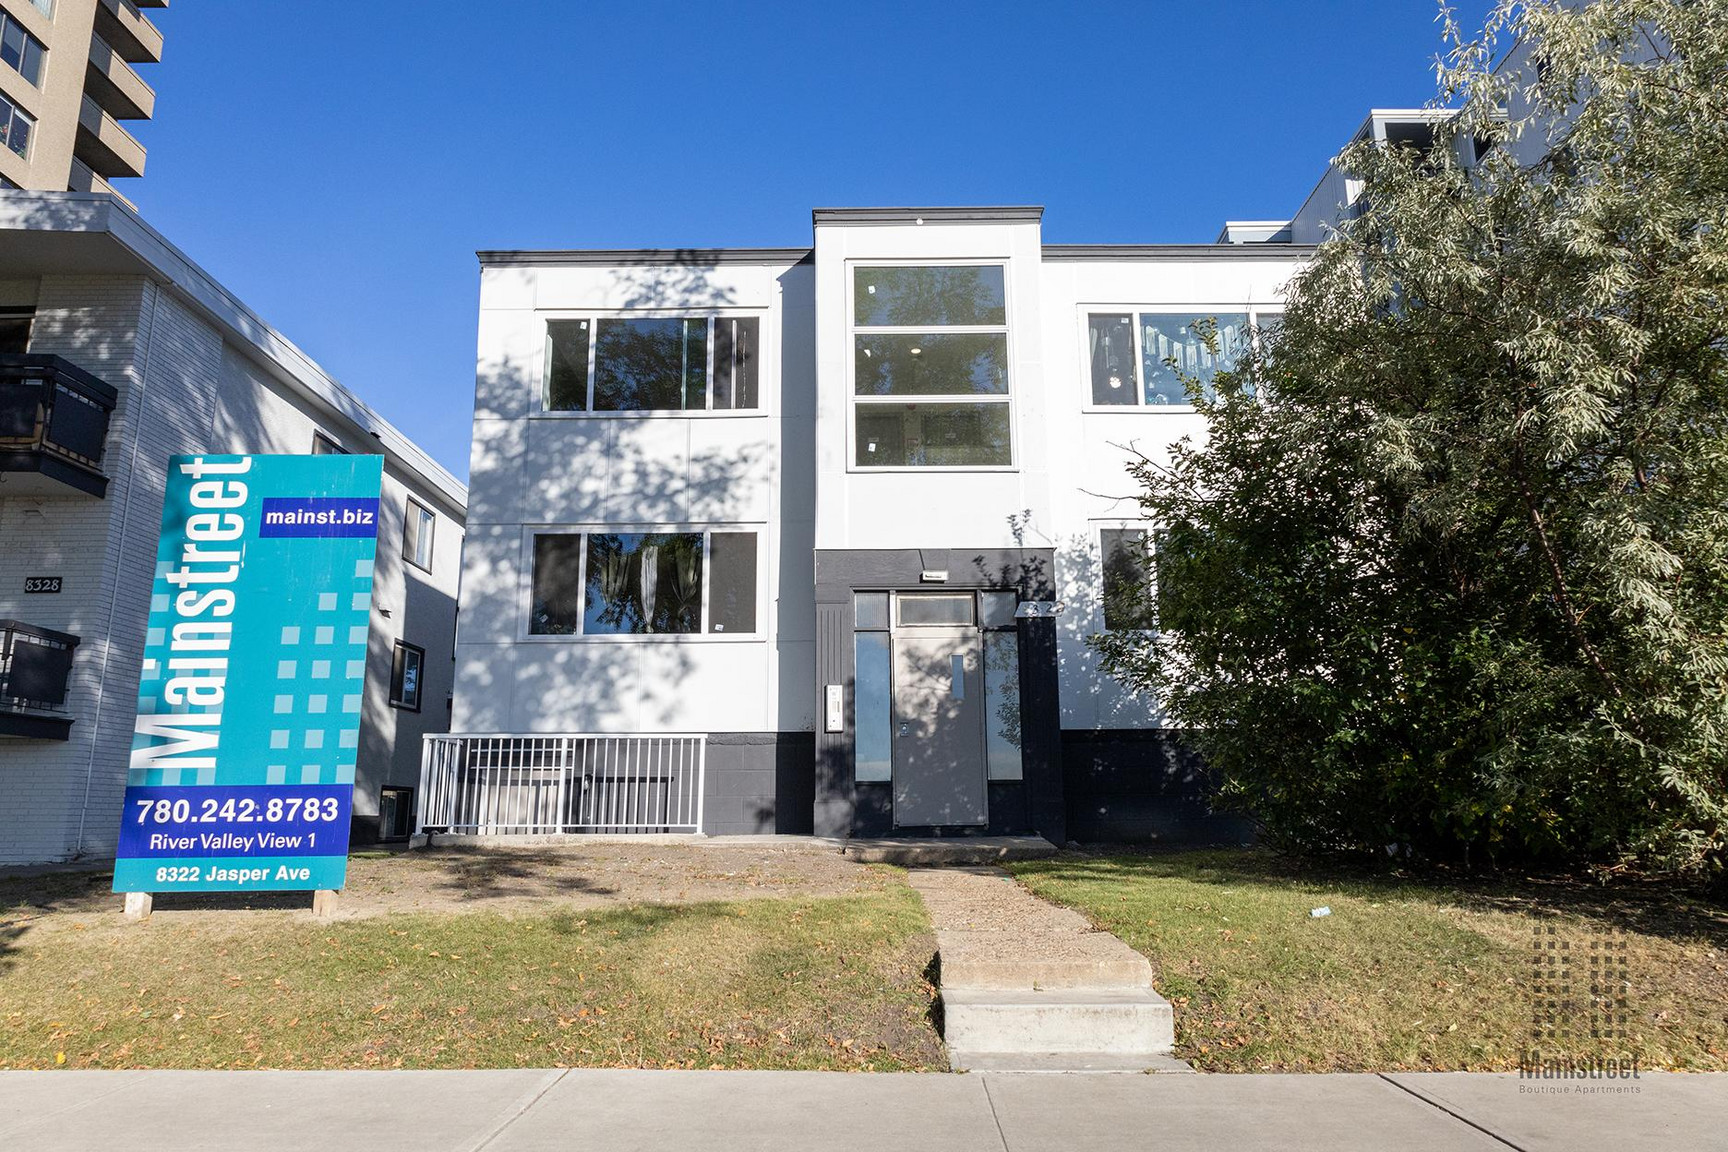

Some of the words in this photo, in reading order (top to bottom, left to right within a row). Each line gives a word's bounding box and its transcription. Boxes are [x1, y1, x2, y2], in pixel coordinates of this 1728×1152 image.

[266, 509, 373, 524] mainst.biz
[25, 579, 60, 591] 8328
[131, 457, 251, 768] Mainstreet
[136, 798, 338, 823] 780.242.8783
[150, 834, 197, 849] River
[200, 834, 254, 851] Valley
[257, 833, 302, 848] View
[308, 833, 316, 848] 1
[156, 867, 200, 882] 8322
[206, 866, 270, 884] Jasper
[275, 866, 310, 881] Ave
